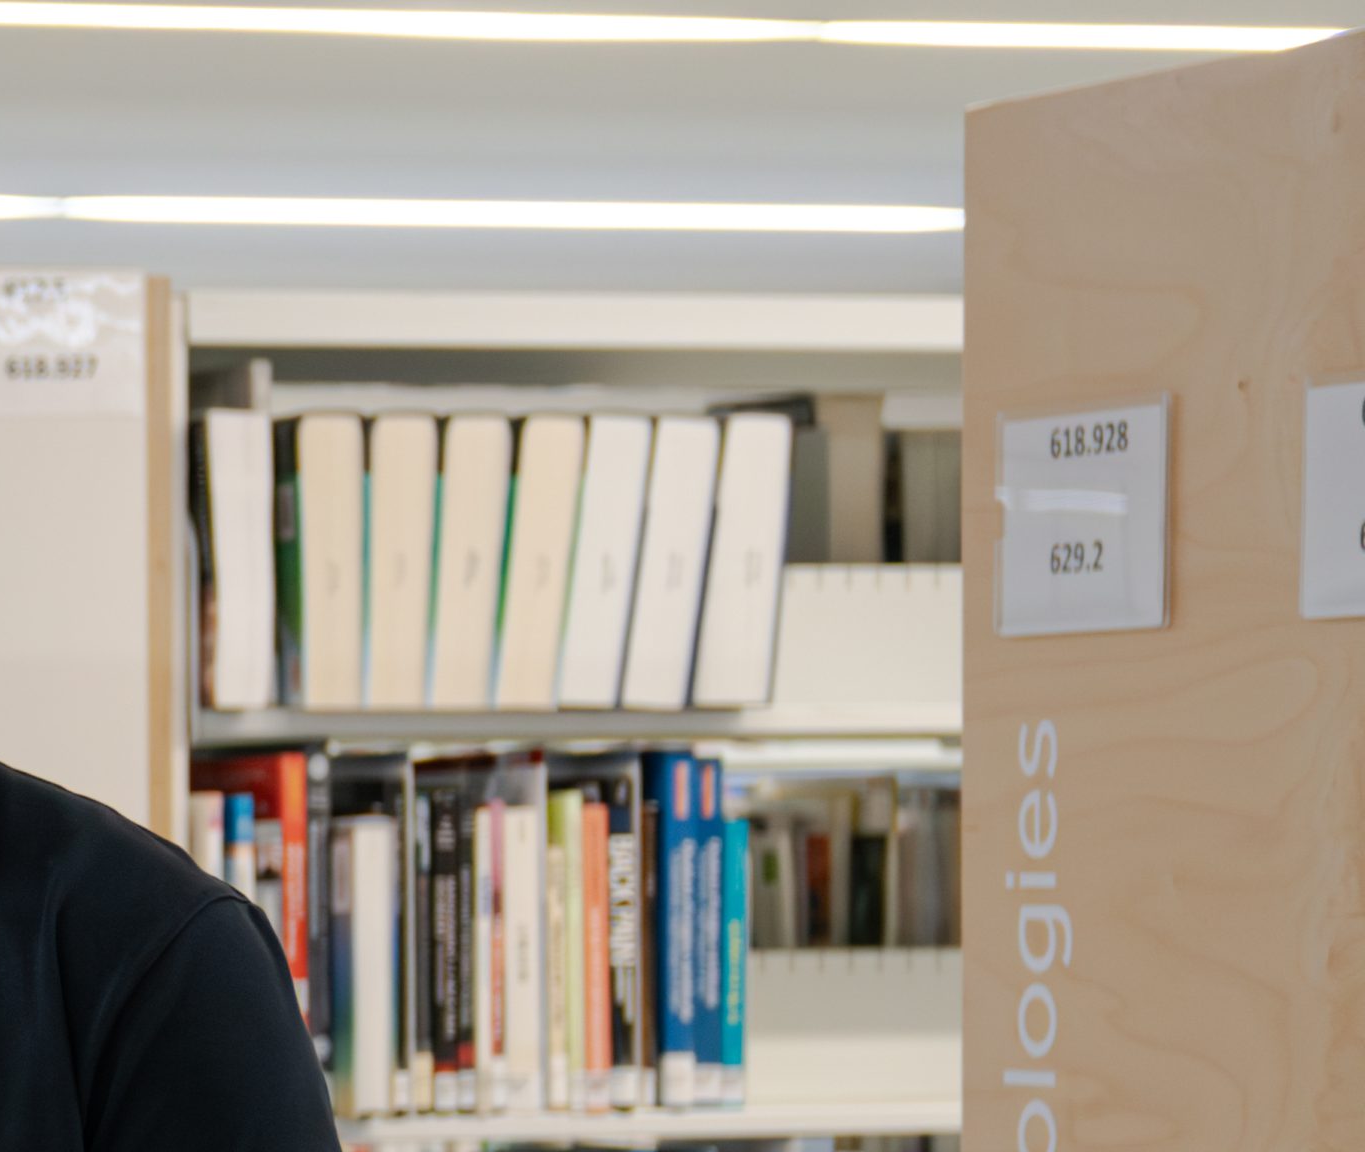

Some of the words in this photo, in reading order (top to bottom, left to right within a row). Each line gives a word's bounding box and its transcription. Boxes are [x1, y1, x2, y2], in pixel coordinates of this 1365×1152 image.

[5, 354, 100, 380] 618.927
[1050, 420, 1129, 459] 618.928
[1050, 541, 1104, 575] 629.2
[609, 834, 636, 900] BACK
[609, 909, 636, 967] PAIN
